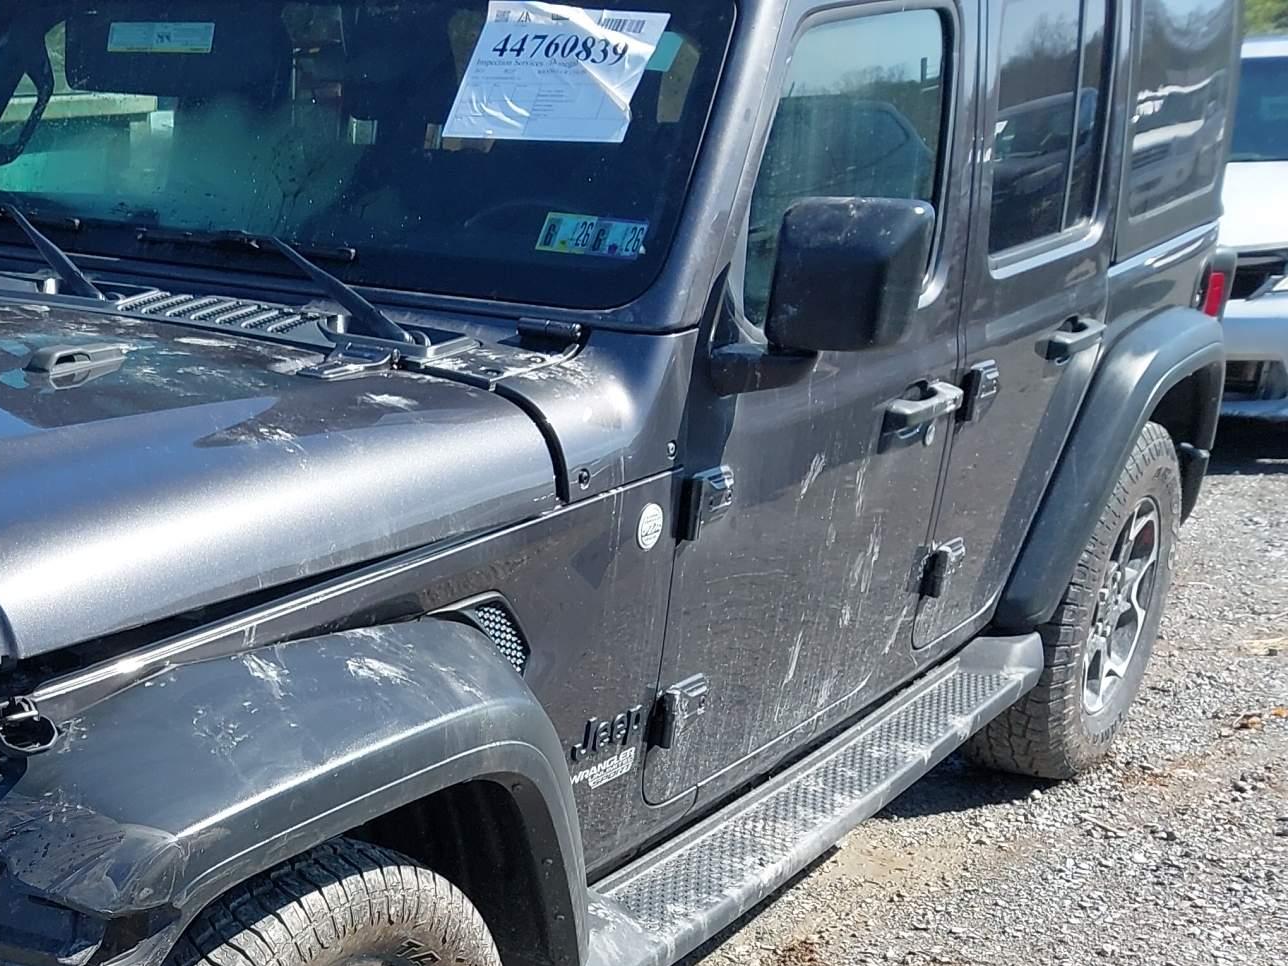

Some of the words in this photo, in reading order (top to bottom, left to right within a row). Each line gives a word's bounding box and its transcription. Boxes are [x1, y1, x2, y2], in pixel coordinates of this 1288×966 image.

[492, 33, 629, 66] 44760839
[543, 223, 557, 247] 6
[575, 221, 594, 247] 26
[625, 227, 644, 253] 26
[571, 704, 643, 762] Jeep
[570, 746, 636, 785] WRANGLER
